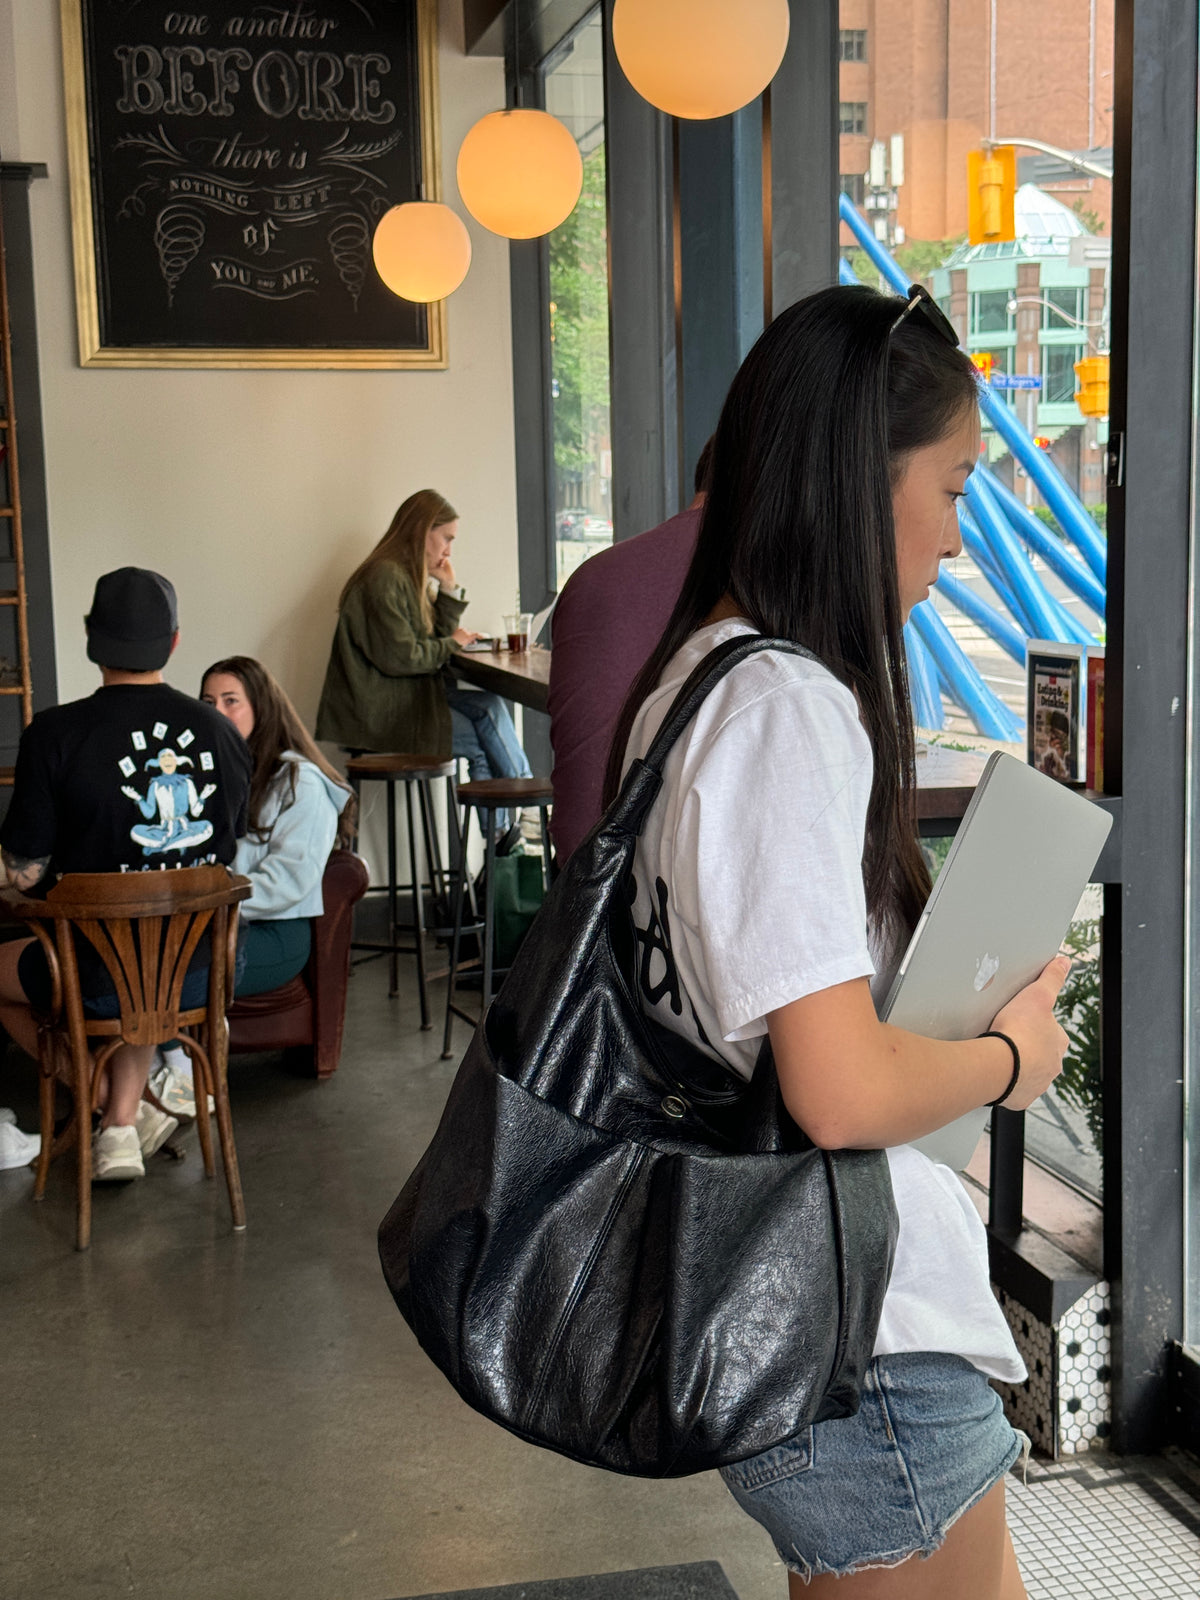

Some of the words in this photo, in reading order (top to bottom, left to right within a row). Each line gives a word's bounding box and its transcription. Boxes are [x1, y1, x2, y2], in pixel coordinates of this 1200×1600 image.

[164, 11, 208, 35] one
[225, 7, 339, 40] another
[114, 45, 397, 125] BEFORE
[211, 131, 282, 169] there
[288, 142, 308, 169] is
[169, 178, 250, 209] NOTHING
[273, 185, 332, 211] LEFT
[243, 217, 282, 256] of
[210, 260, 251, 286] YOU
